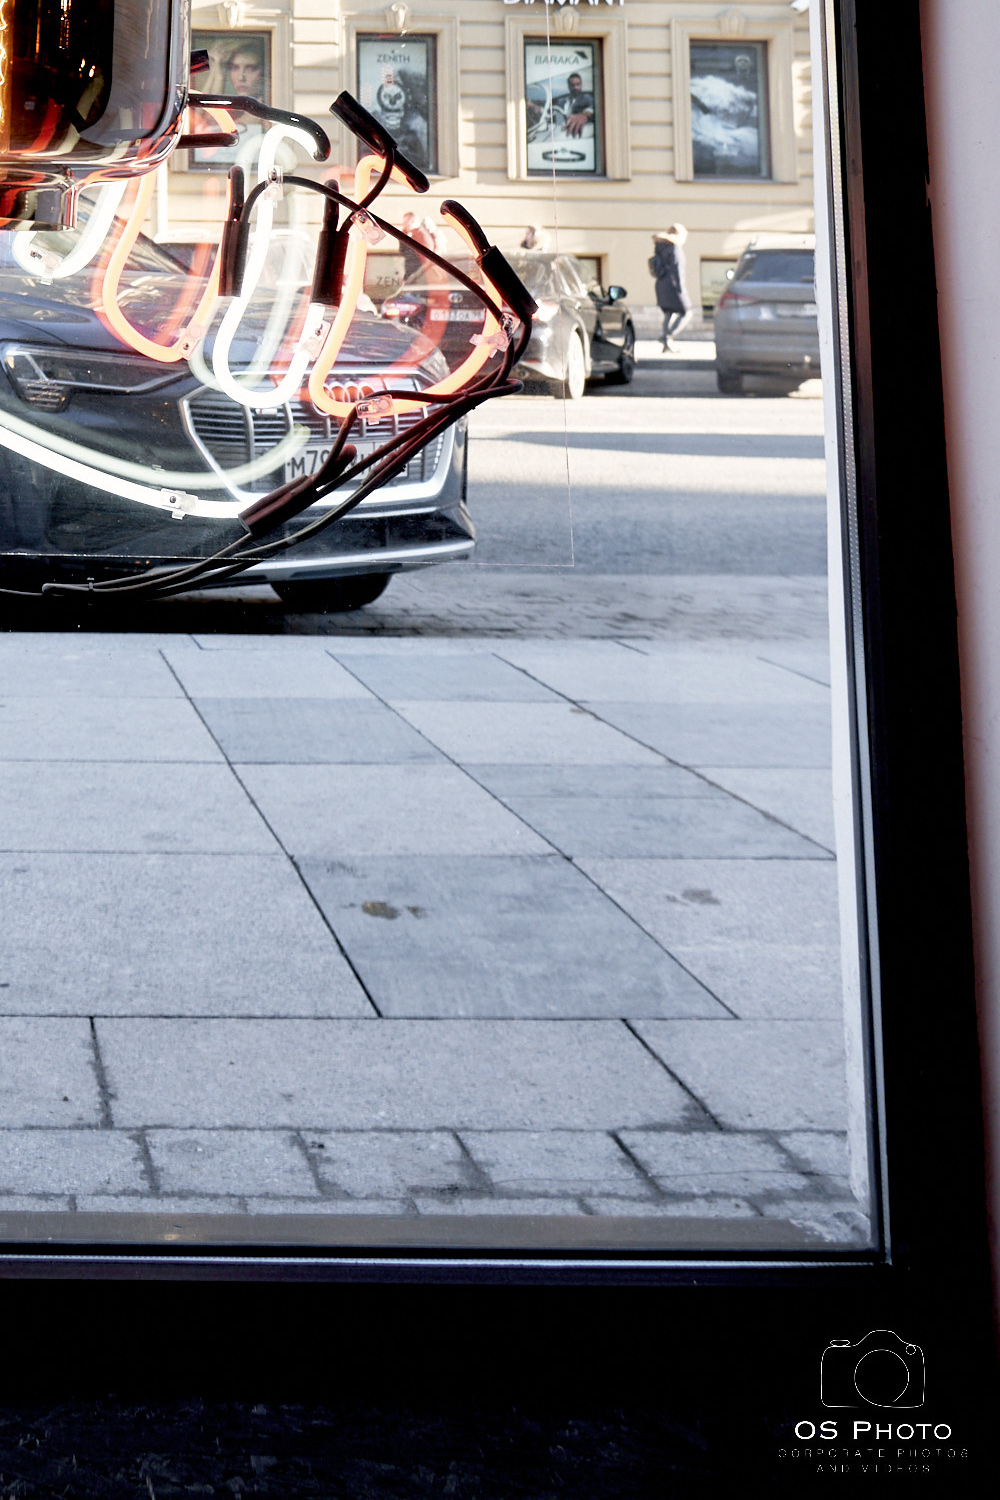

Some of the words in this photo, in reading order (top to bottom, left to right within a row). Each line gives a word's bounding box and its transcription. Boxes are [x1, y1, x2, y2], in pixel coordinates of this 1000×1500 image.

[376, 54, 410, 63] ZENITH
[534, 55, 580, 65] BARAKA
[376, 276, 402, 287] ZEN
